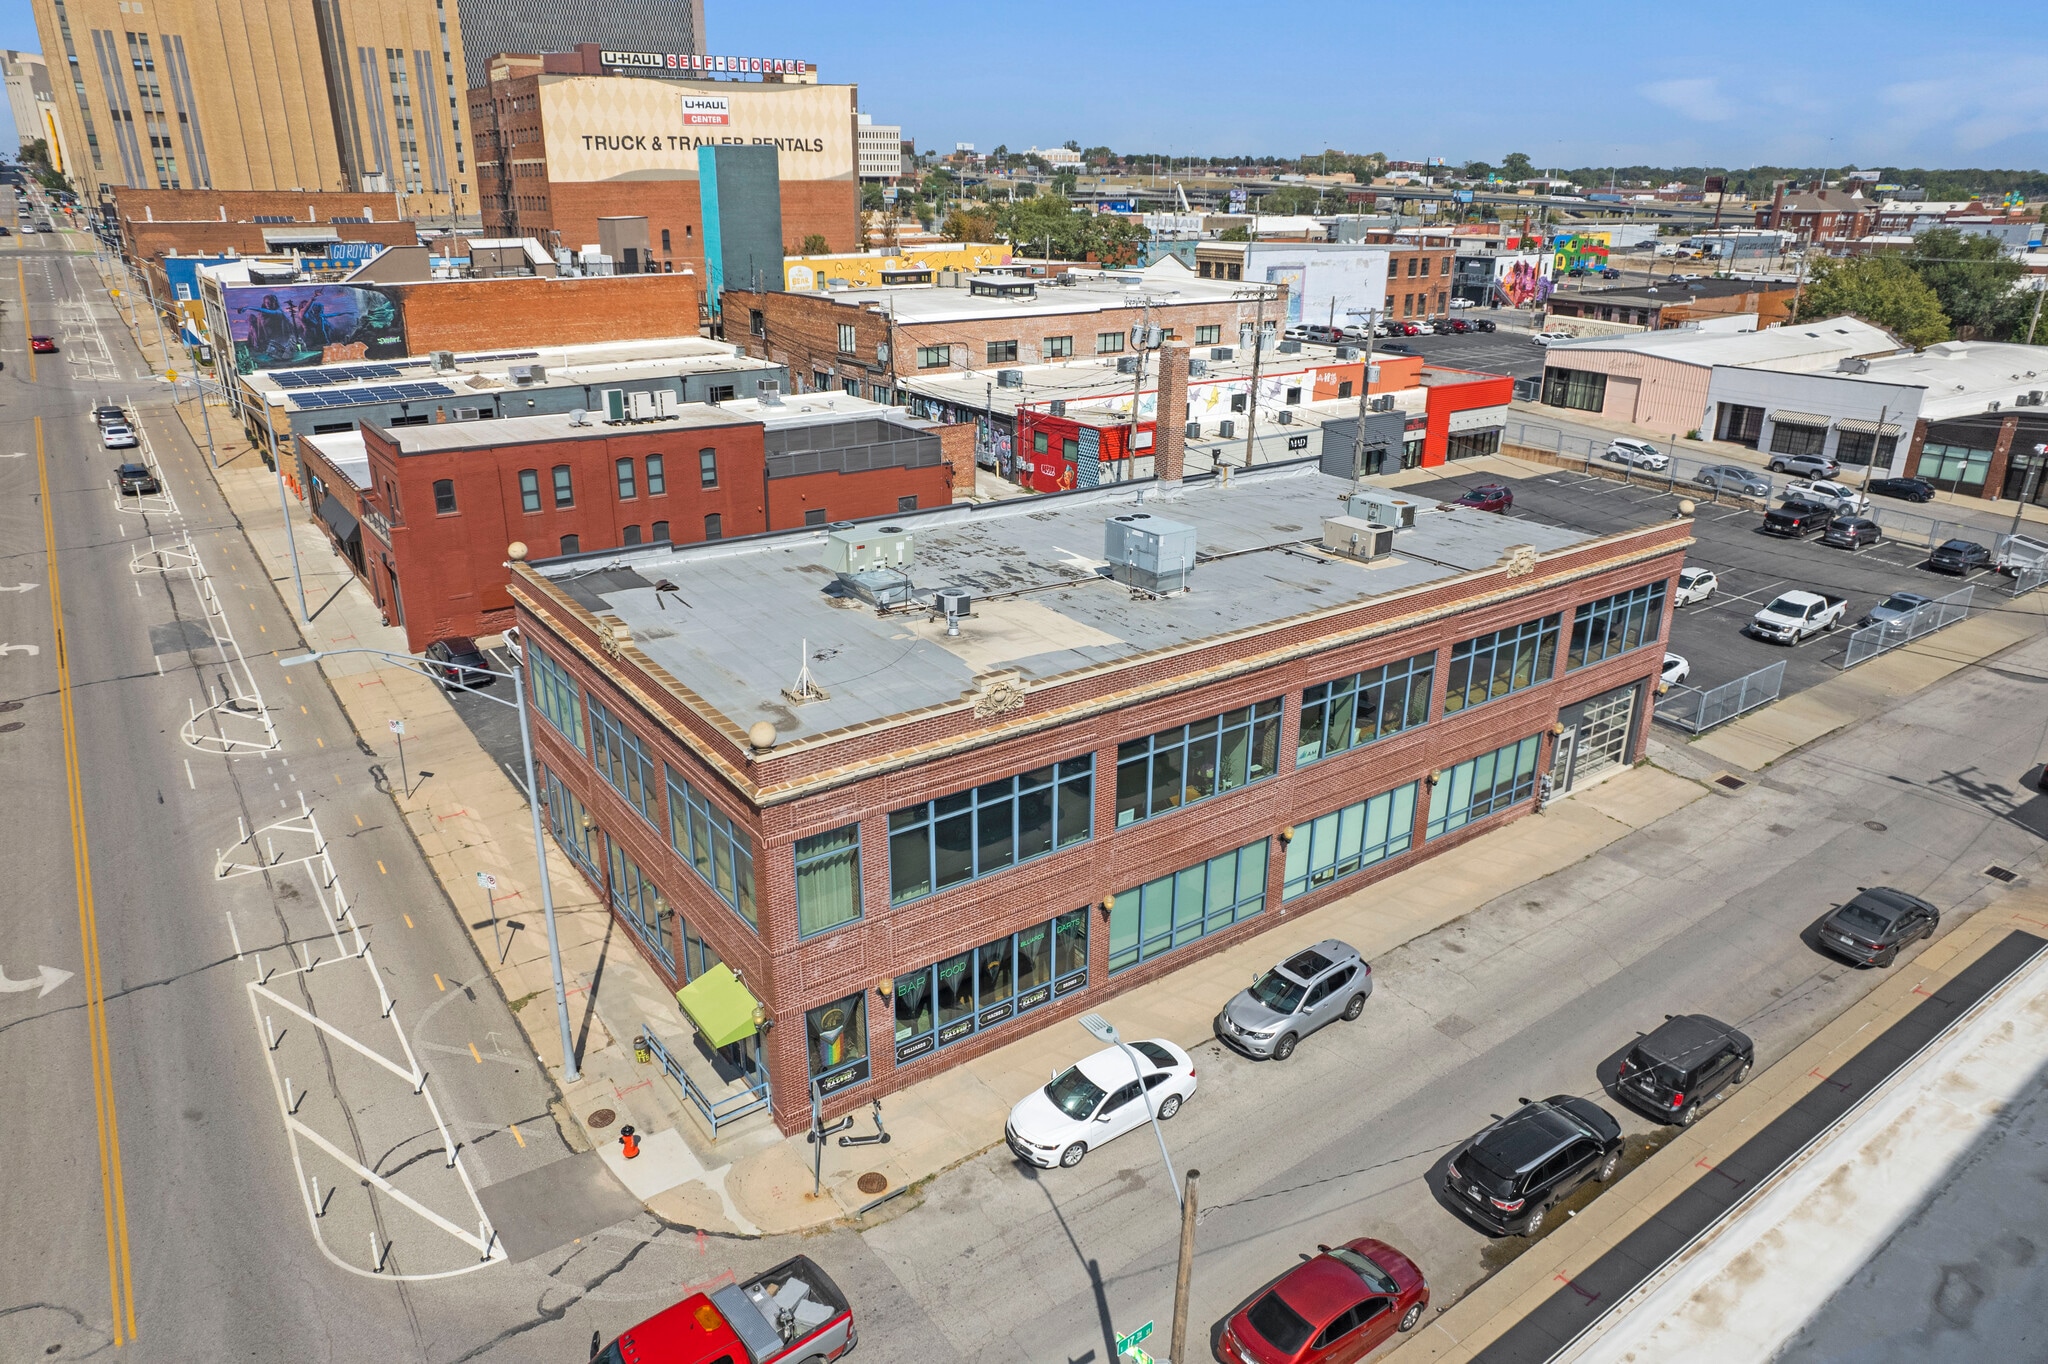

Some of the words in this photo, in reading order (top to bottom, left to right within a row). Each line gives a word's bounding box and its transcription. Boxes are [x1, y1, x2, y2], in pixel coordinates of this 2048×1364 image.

[604, 52, 660, 65] U-HAUL
[667, 55, 805, 73] SELF-STORAGE
[684, 99, 727, 110] U-HAUL
[691, 115, 722, 124] CENTER
[581, 135, 647, 151] TRUCK
[651, 135, 663, 151] &
[333, 244, 346, 260] GO
[1057, 918, 1081, 934] DARTS
[940, 961, 967, 981] FOOD
[898, 976, 926, 997] BAR
